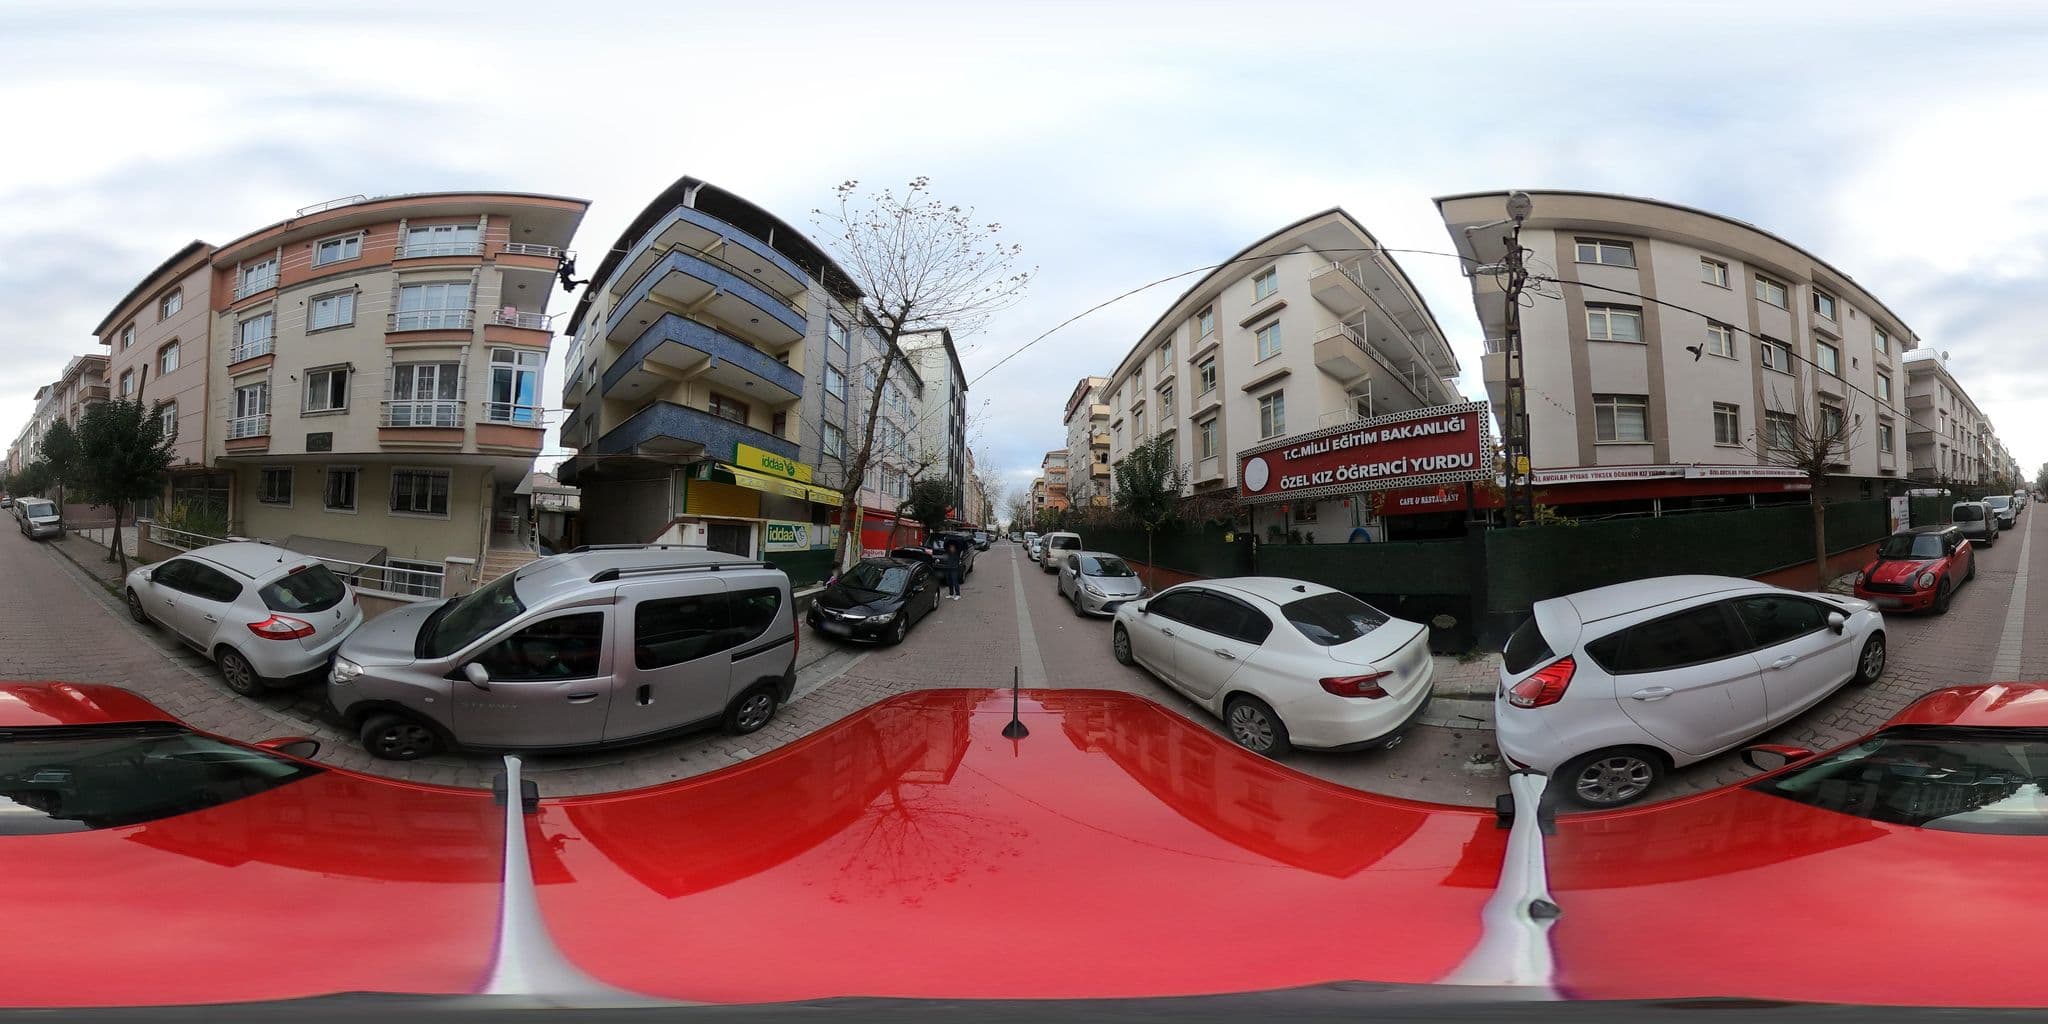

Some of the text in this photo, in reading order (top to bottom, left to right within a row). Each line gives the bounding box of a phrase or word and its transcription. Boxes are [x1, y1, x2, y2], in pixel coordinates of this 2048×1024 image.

[1333, 431, 1377, 451] EĞİTİM
[1381, 416, 1465, 442] BAKANLIĞI
[761, 456, 784, 471] iddaa
[1280, 452, 1473, 490] ÖZEL KIZ ÖĞRENCİ YURDU
[1400, 497, 1414, 506] CAFE
[769, 526, 794, 541] iddaa
